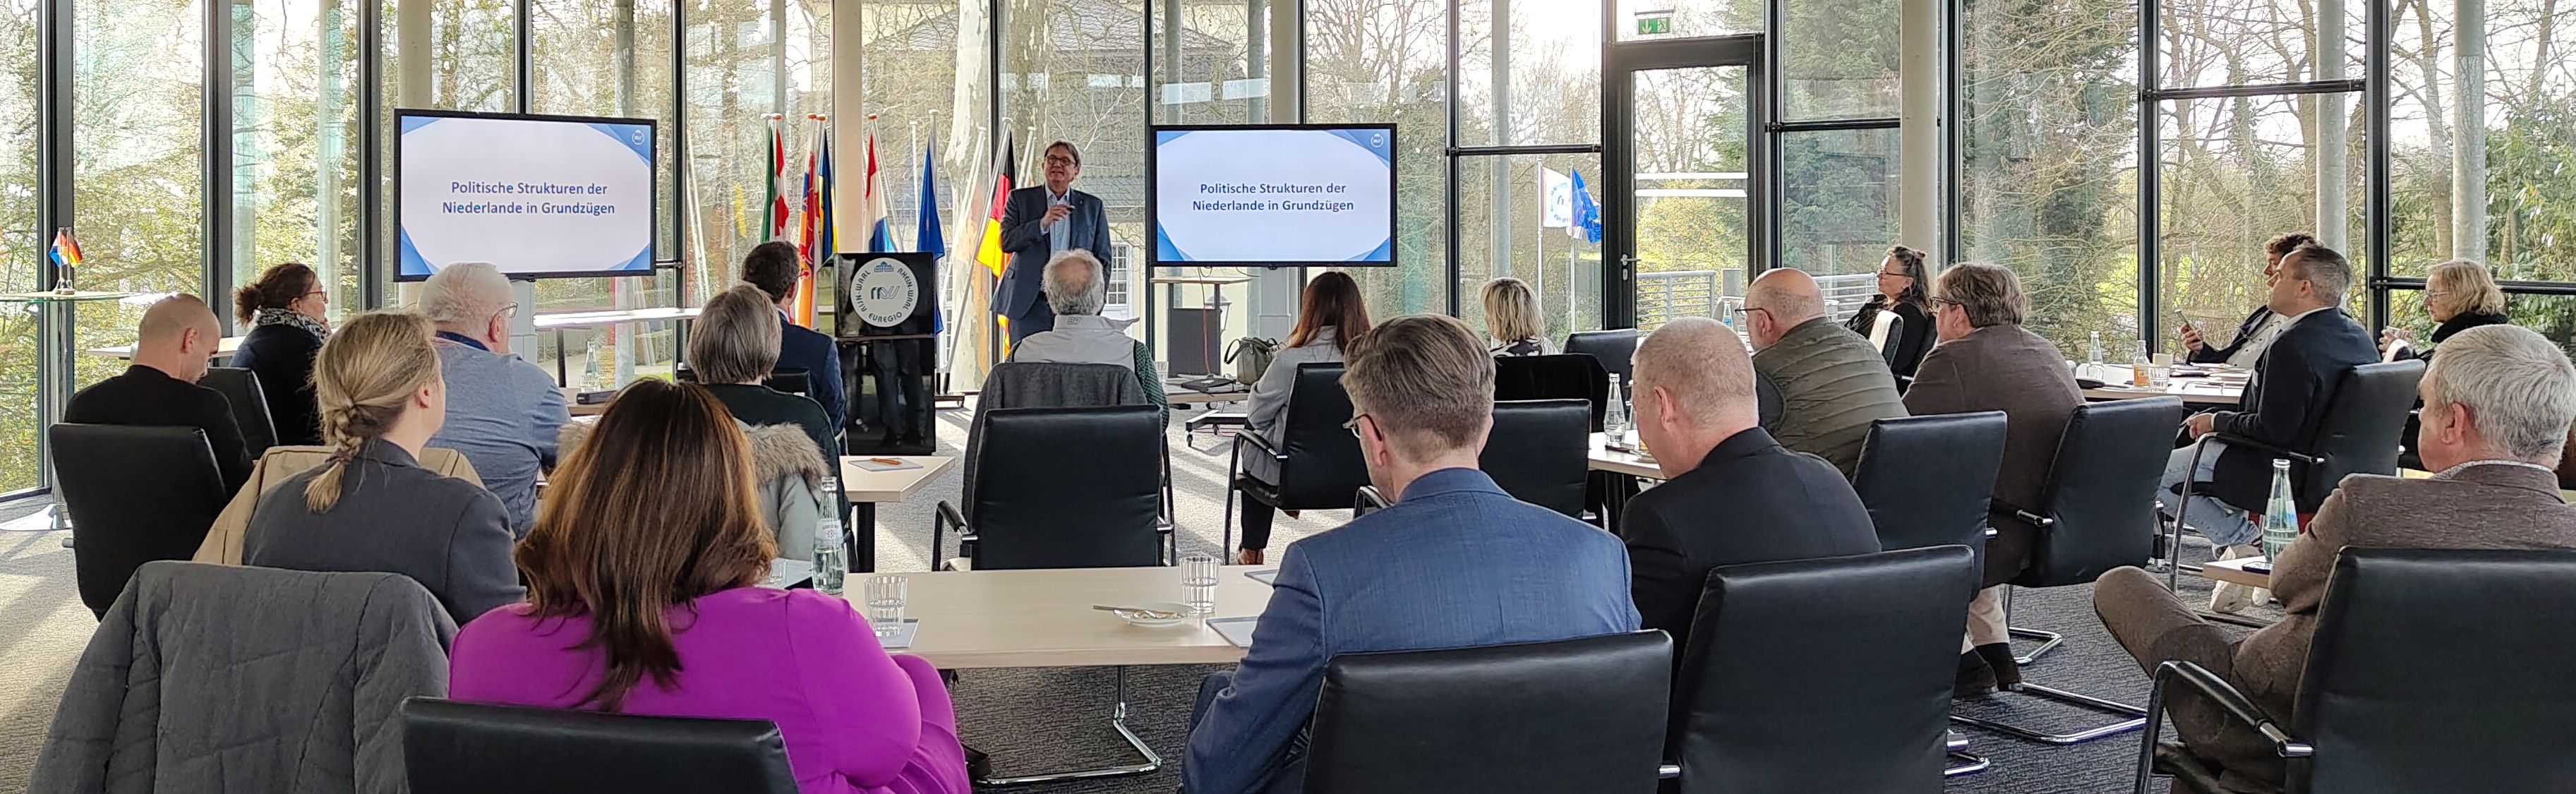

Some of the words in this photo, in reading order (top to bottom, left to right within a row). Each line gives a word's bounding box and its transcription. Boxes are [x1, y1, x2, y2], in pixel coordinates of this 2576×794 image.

[451, 181, 514, 194] Politische
[517, 181, 584, 194] Strukturen
[587, 182, 608, 195] der
[1200, 183, 1256, 193] Politische
[1259, 183, 1323, 193] Strukturen
[1326, 182, 1347, 193] der
[443, 201, 522, 214] Niederlande
[526, 201, 538, 214] in
[541, 202, 615, 216] Grundzügen
[1193, 200, 1265, 210] Niederlande
[1268, 200, 1278, 210] in
[1282, 200, 1354, 212] Grundzügen
[868, 311, 903, 323] EUREGIO
